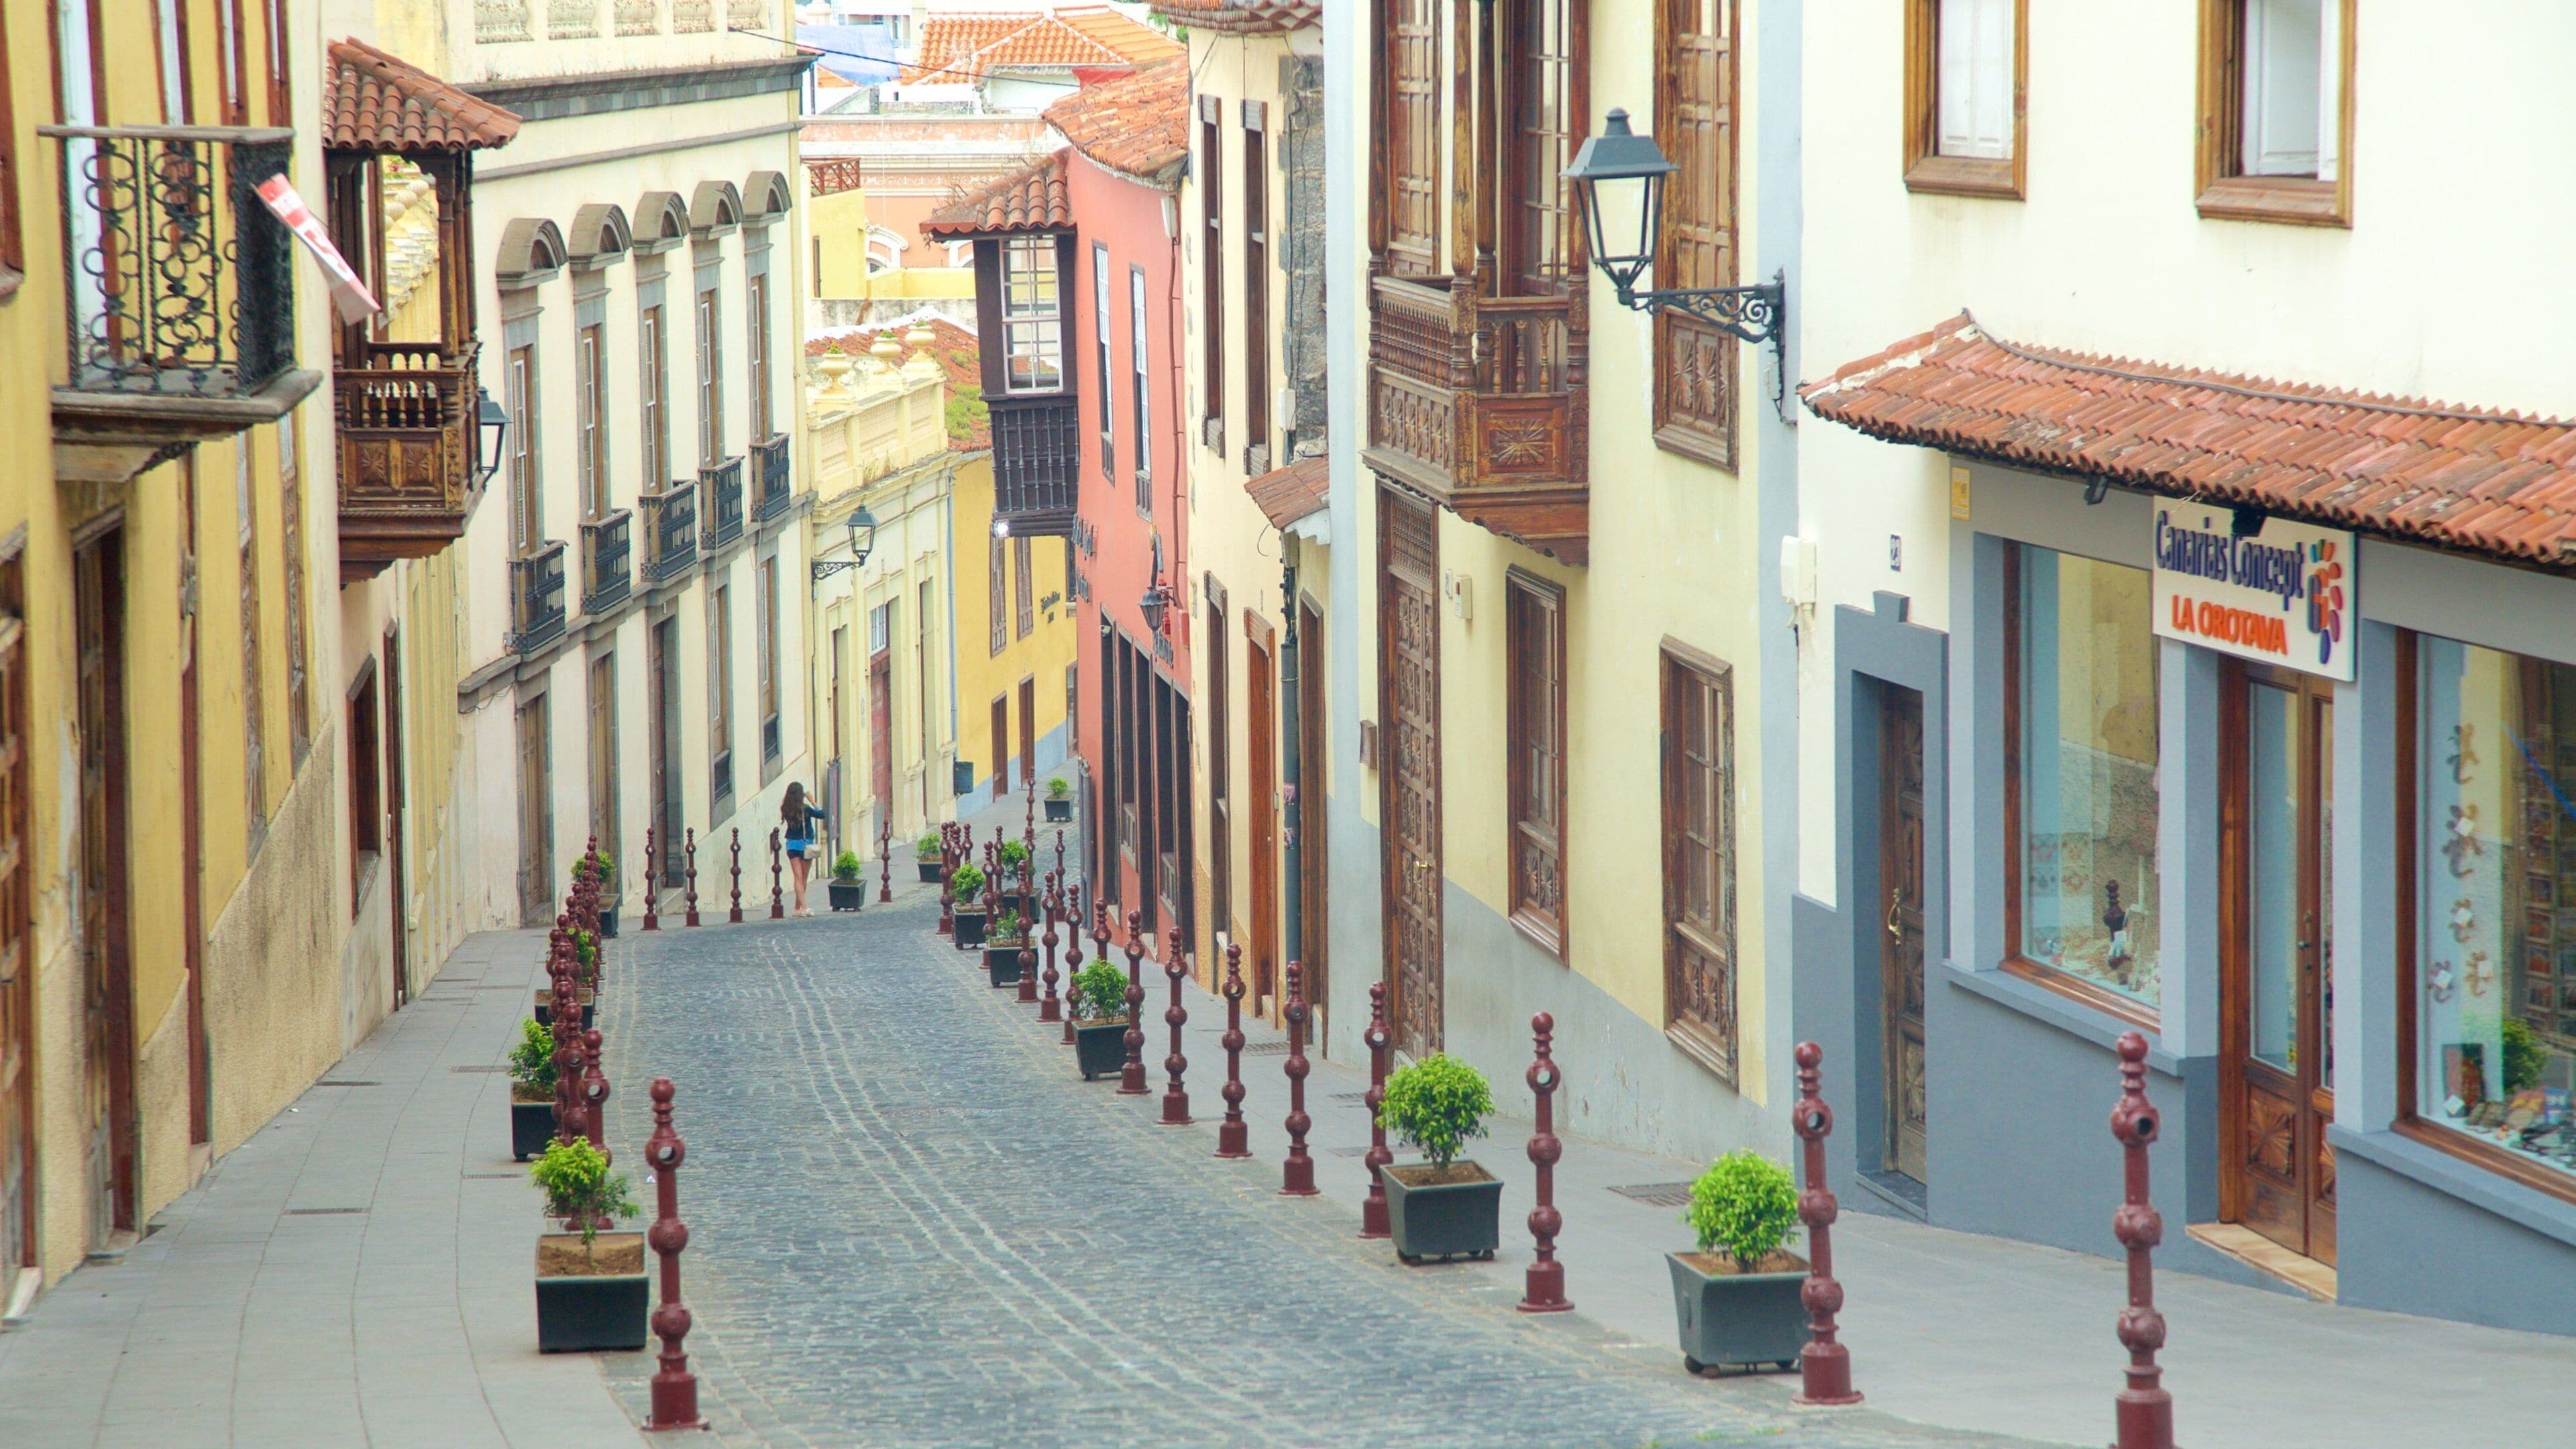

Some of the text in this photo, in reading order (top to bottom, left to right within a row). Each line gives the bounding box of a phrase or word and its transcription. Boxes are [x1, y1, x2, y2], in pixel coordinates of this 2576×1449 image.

[2155, 511, 2304, 611] Canarias Concept
[2171, 594, 2288, 655] LA OROTAVA
